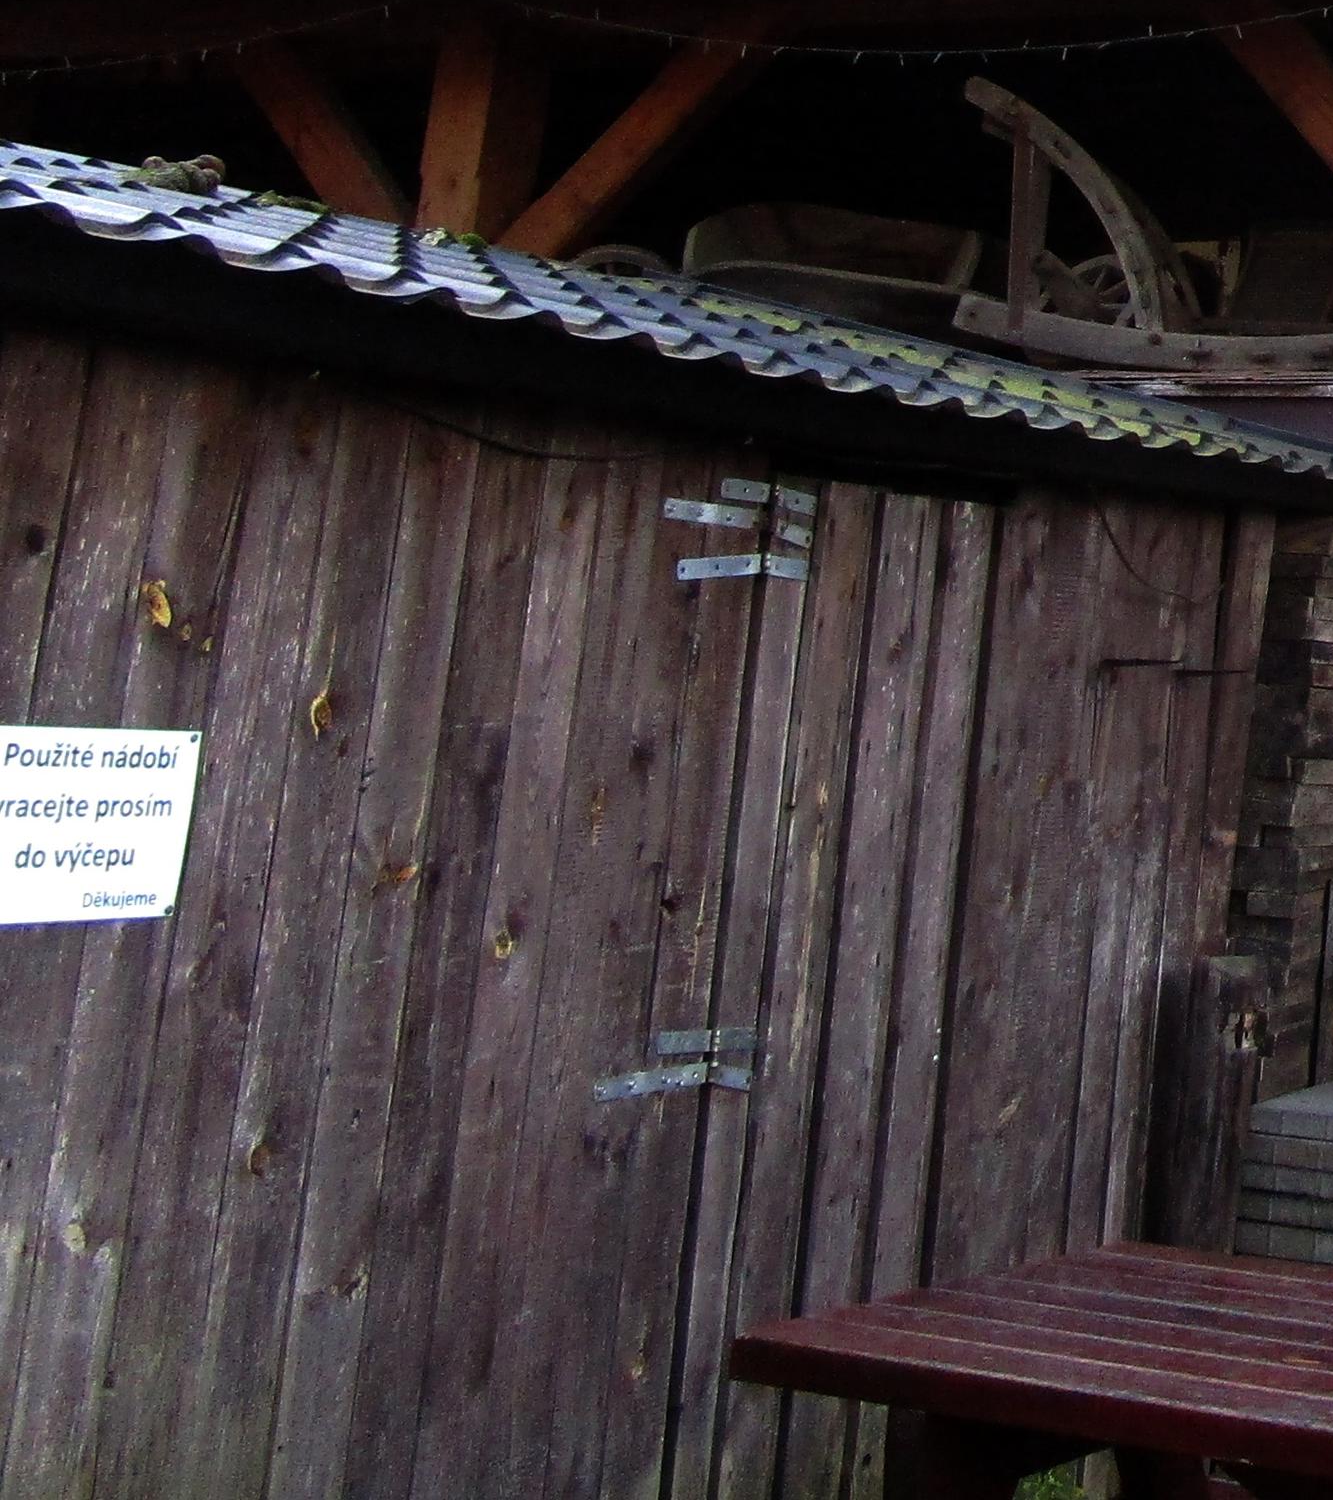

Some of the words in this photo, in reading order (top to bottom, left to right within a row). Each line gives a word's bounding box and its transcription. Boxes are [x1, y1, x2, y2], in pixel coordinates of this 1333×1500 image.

[4, 742, 95, 768] Použité
[100, 744, 180, 769] nádobí
[95, 793, 173, 822] prosím
[15, 843, 46, 869] do
[54, 842, 135, 873] výčepu
[82, 890, 157, 910] Děkujeme
